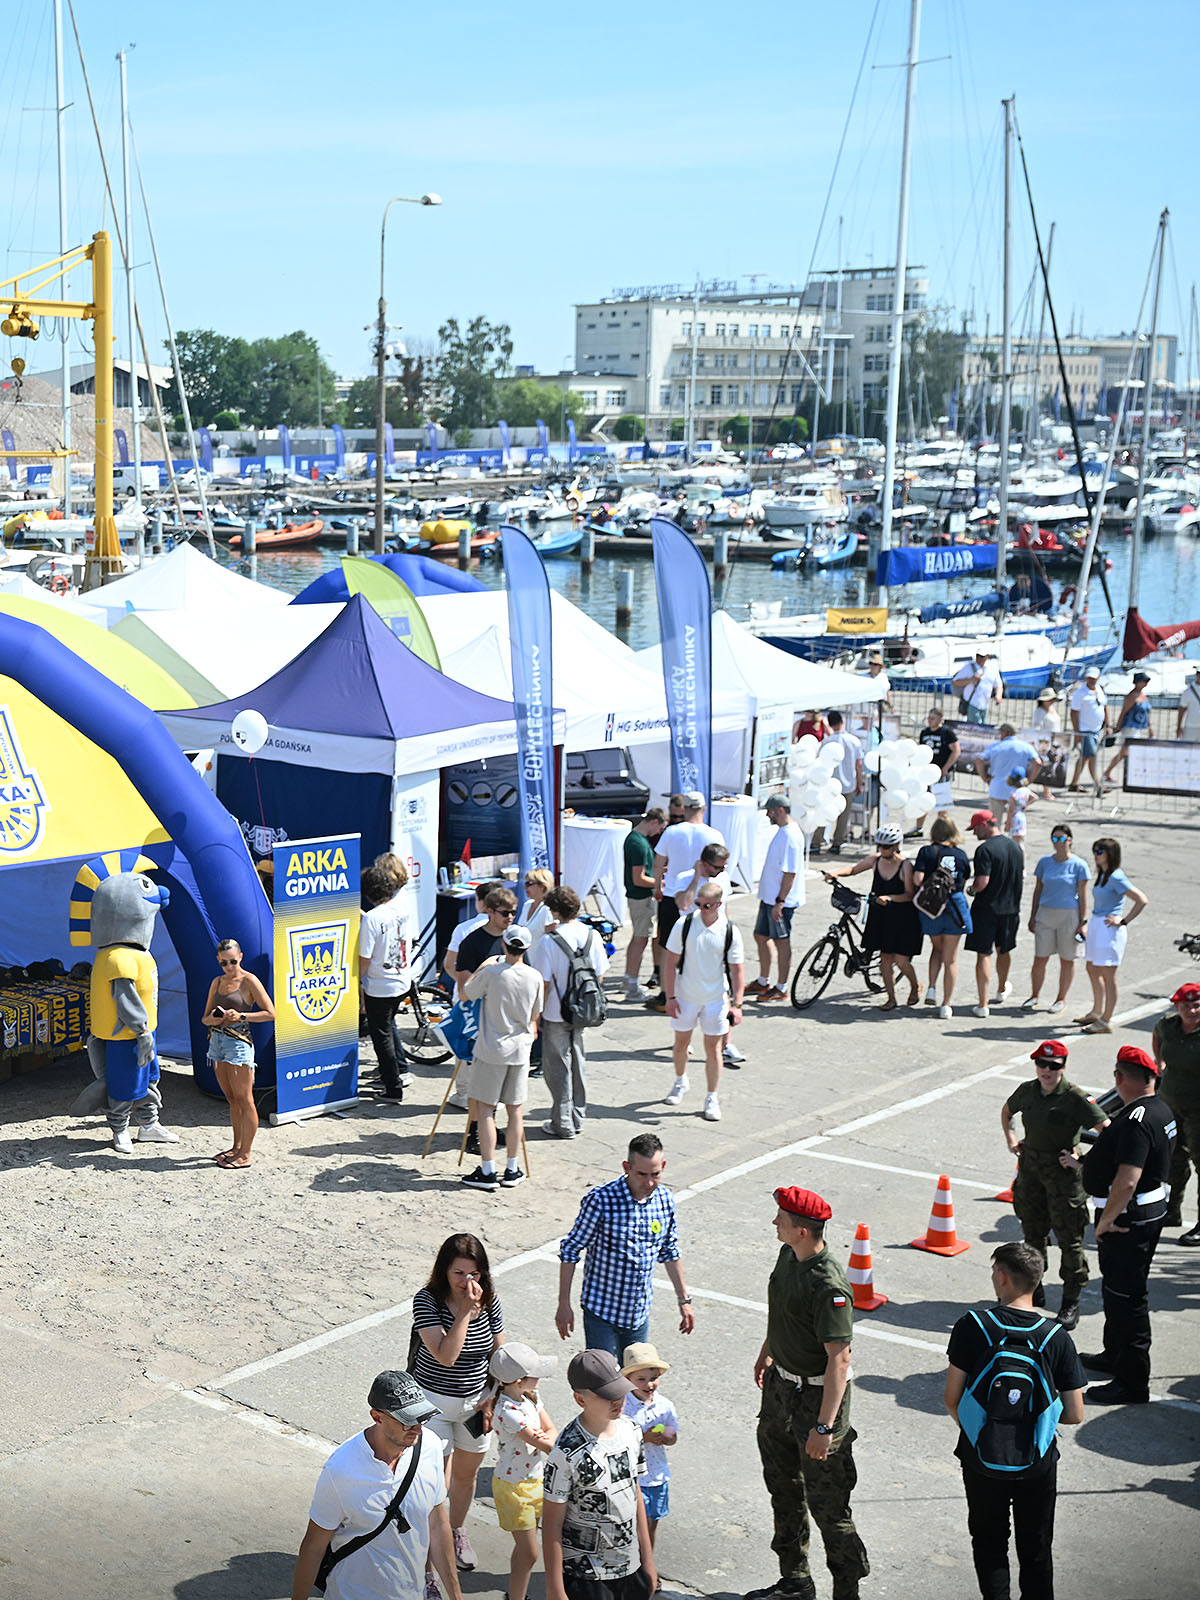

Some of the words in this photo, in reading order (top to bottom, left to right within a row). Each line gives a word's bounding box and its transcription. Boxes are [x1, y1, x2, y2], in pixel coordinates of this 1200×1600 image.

[924, 550, 974, 574] HADAR
[616, 721, 631, 733] HG
[275, 739, 312, 753] GDAŃSKA
[286, 847, 348, 877] ARKA
[285, 872, 349, 897] GDYNIA
[299, 975, 337, 991] ARKA
